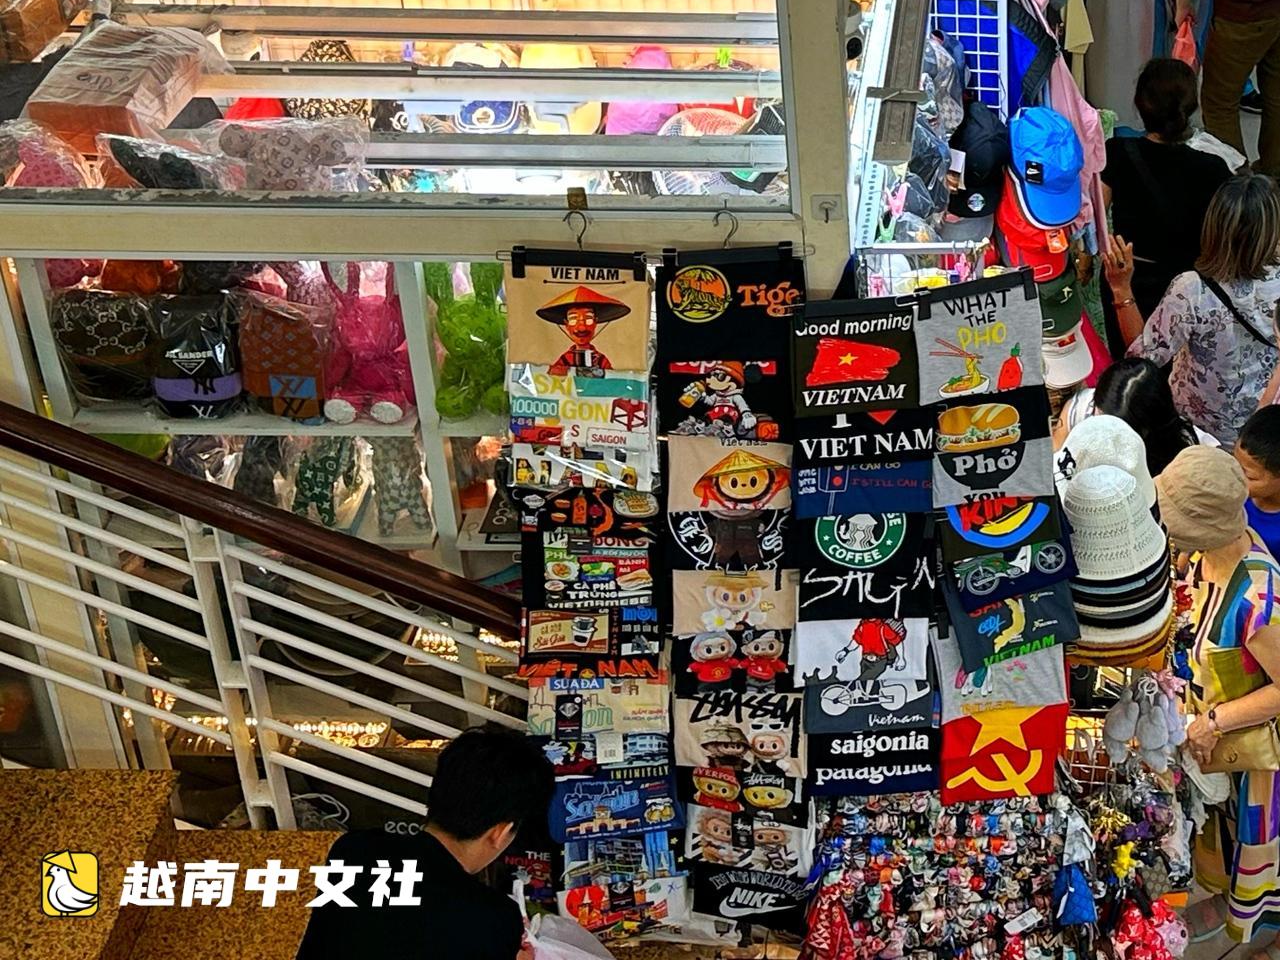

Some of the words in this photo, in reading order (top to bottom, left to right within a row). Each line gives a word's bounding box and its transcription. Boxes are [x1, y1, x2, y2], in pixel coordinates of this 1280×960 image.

[551, 267, 581, 280] VIET
[585, 268, 619, 280] NAM
[737, 281, 801, 317] Tige
[943, 289, 1011, 315] WHAT
[844, 313, 913, 335] morning
[964, 310, 997, 327] THE
[957, 321, 1007, 348] PHO
[803, 384, 907, 406] VIETNAM
[560, 400, 610, 423] GON
[591, 433, 626, 445] SAIGON
[800, 434, 867, 460] VIET
[874, 427, 933, 455] NAM
[952, 448, 1018, 477] Phở
[828, 544, 883, 563] COFFEE
[597, 659, 659, 677] NAM
[868, 713, 926, 727] Vietnam
[830, 730, 929, 758] saigonia
[384, 821, 425, 836] ecc
[525, 850, 551, 861] THE
[728, 887, 780, 909] NIKE
